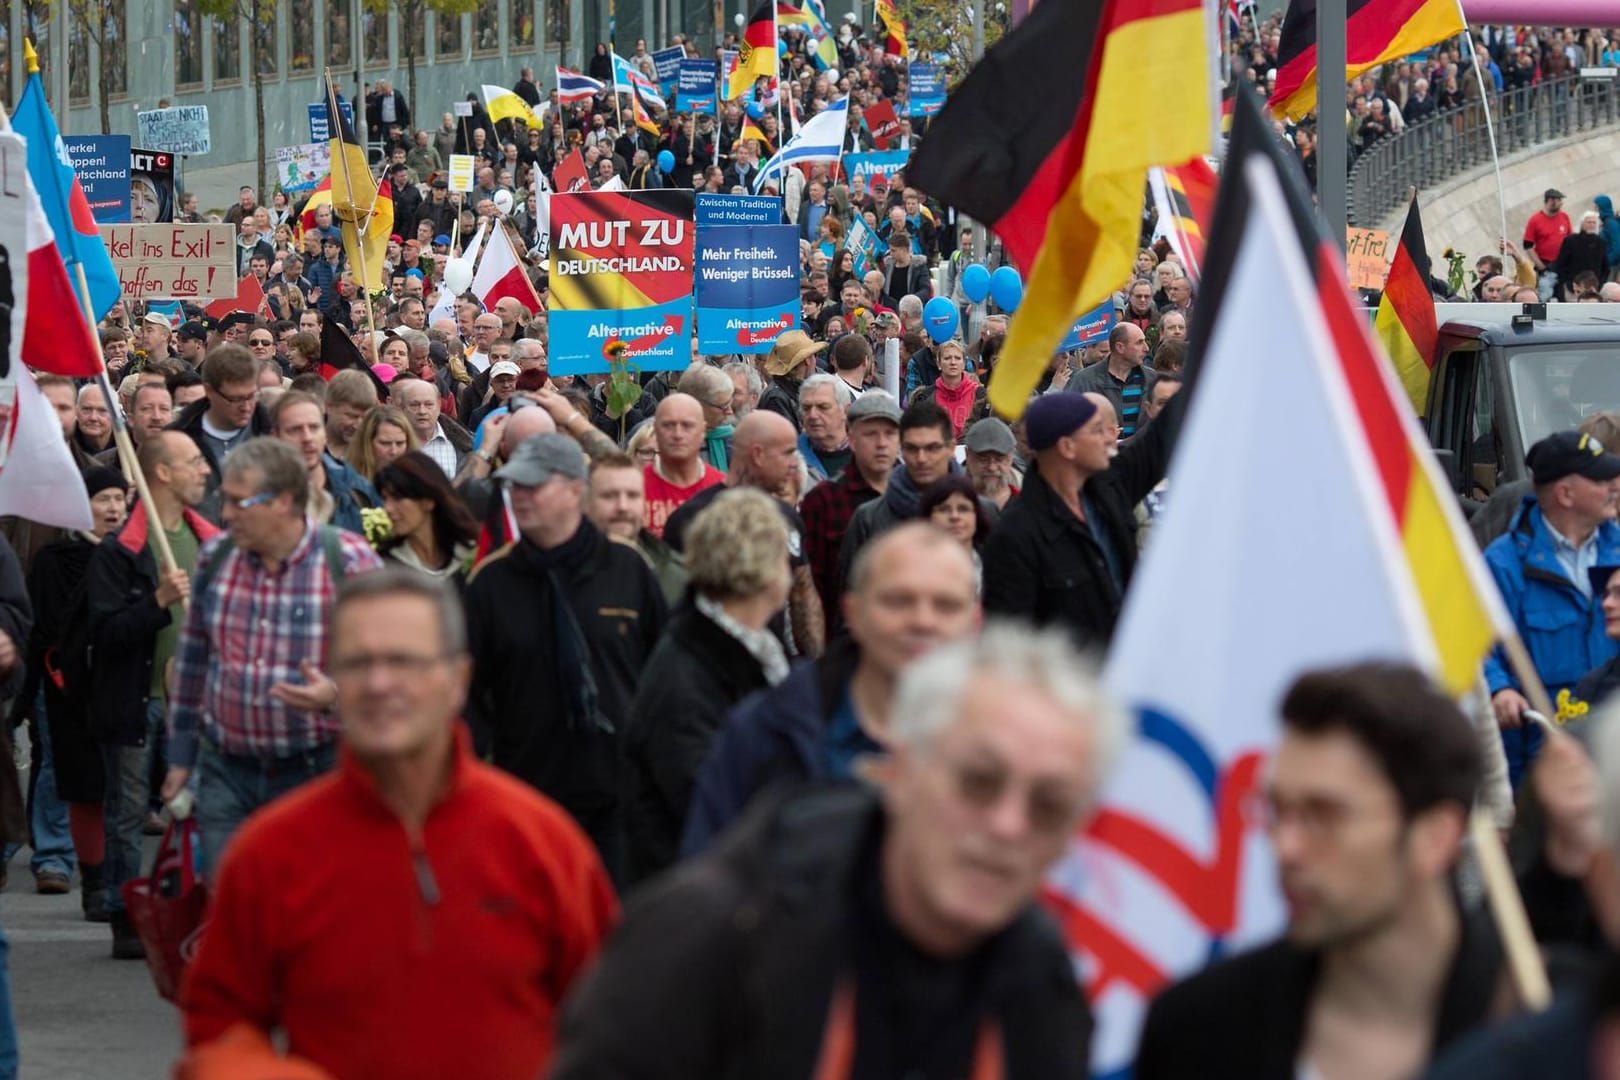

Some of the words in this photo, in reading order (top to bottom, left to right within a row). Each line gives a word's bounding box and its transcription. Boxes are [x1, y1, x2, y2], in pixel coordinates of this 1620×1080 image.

[139, 111, 163, 124] STAAT
[179, 107, 205, 121] NICHT
[70, 156, 106, 168] oppen!
[74, 169, 126, 180] utschland
[700, 199, 738, 208] Zwischen
[740, 200, 777, 209] Tradition
[726, 212, 769, 221] Moderne!
[104, 227, 134, 258] kel
[143, 242, 163, 258] ins
[558, 220, 632, 250] MUT
[639, 219, 684, 246] ZU
[702, 248, 732, 261] Mehr
[734, 246, 778, 260] Freiheit.
[557, 256, 685, 276] DEUTSCHLAND.
[702, 267, 749, 283] Weniger
[751, 265, 795, 279] Brüssel.
[119, 266, 163, 298] haffen
[172, 266, 199, 293] das
[587, 321, 675, 338] Alternative
[726, 317, 788, 329] Alternative
[621, 347, 674, 357] Deutschland
